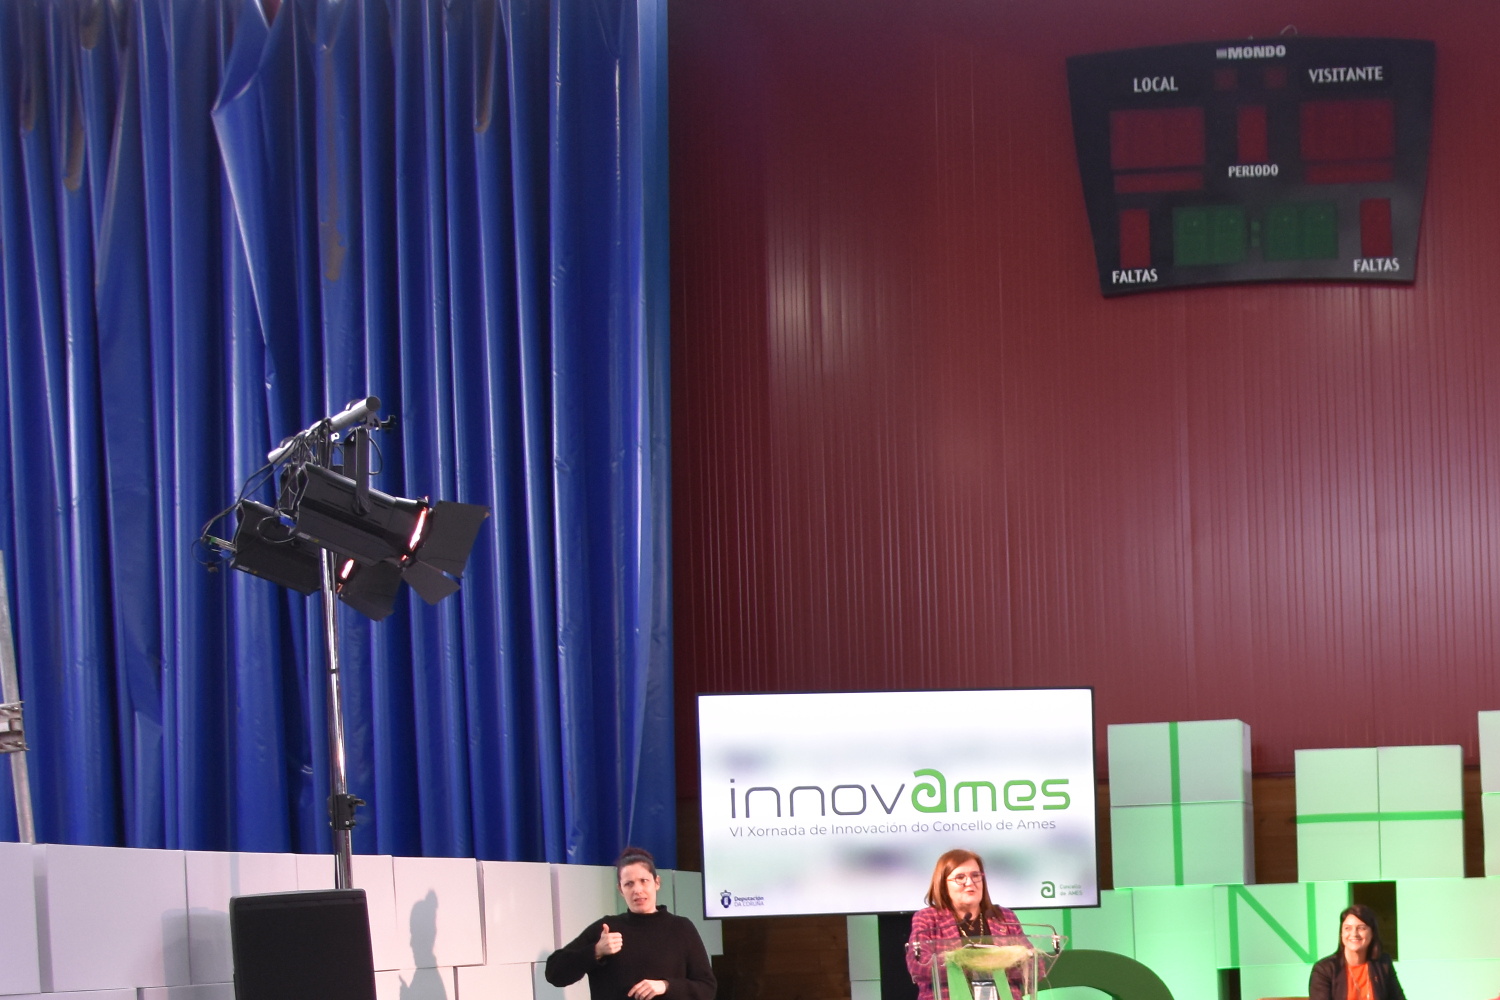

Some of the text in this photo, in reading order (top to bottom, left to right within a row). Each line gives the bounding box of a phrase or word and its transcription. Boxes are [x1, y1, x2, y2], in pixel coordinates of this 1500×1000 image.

[1227, 45, 1286, 60] MONDO
[1308, 66, 1384, 84] VISITANTE
[1133, 76, 1179, 93] LOCAL
[1228, 164, 1279, 178] PERIODO
[1353, 258, 1400, 273] FALTAS
[1112, 268, 1158, 284] FALTAS
[729, 819, 1056, 837] VI Xornada de Innovación do Concello de Ames
